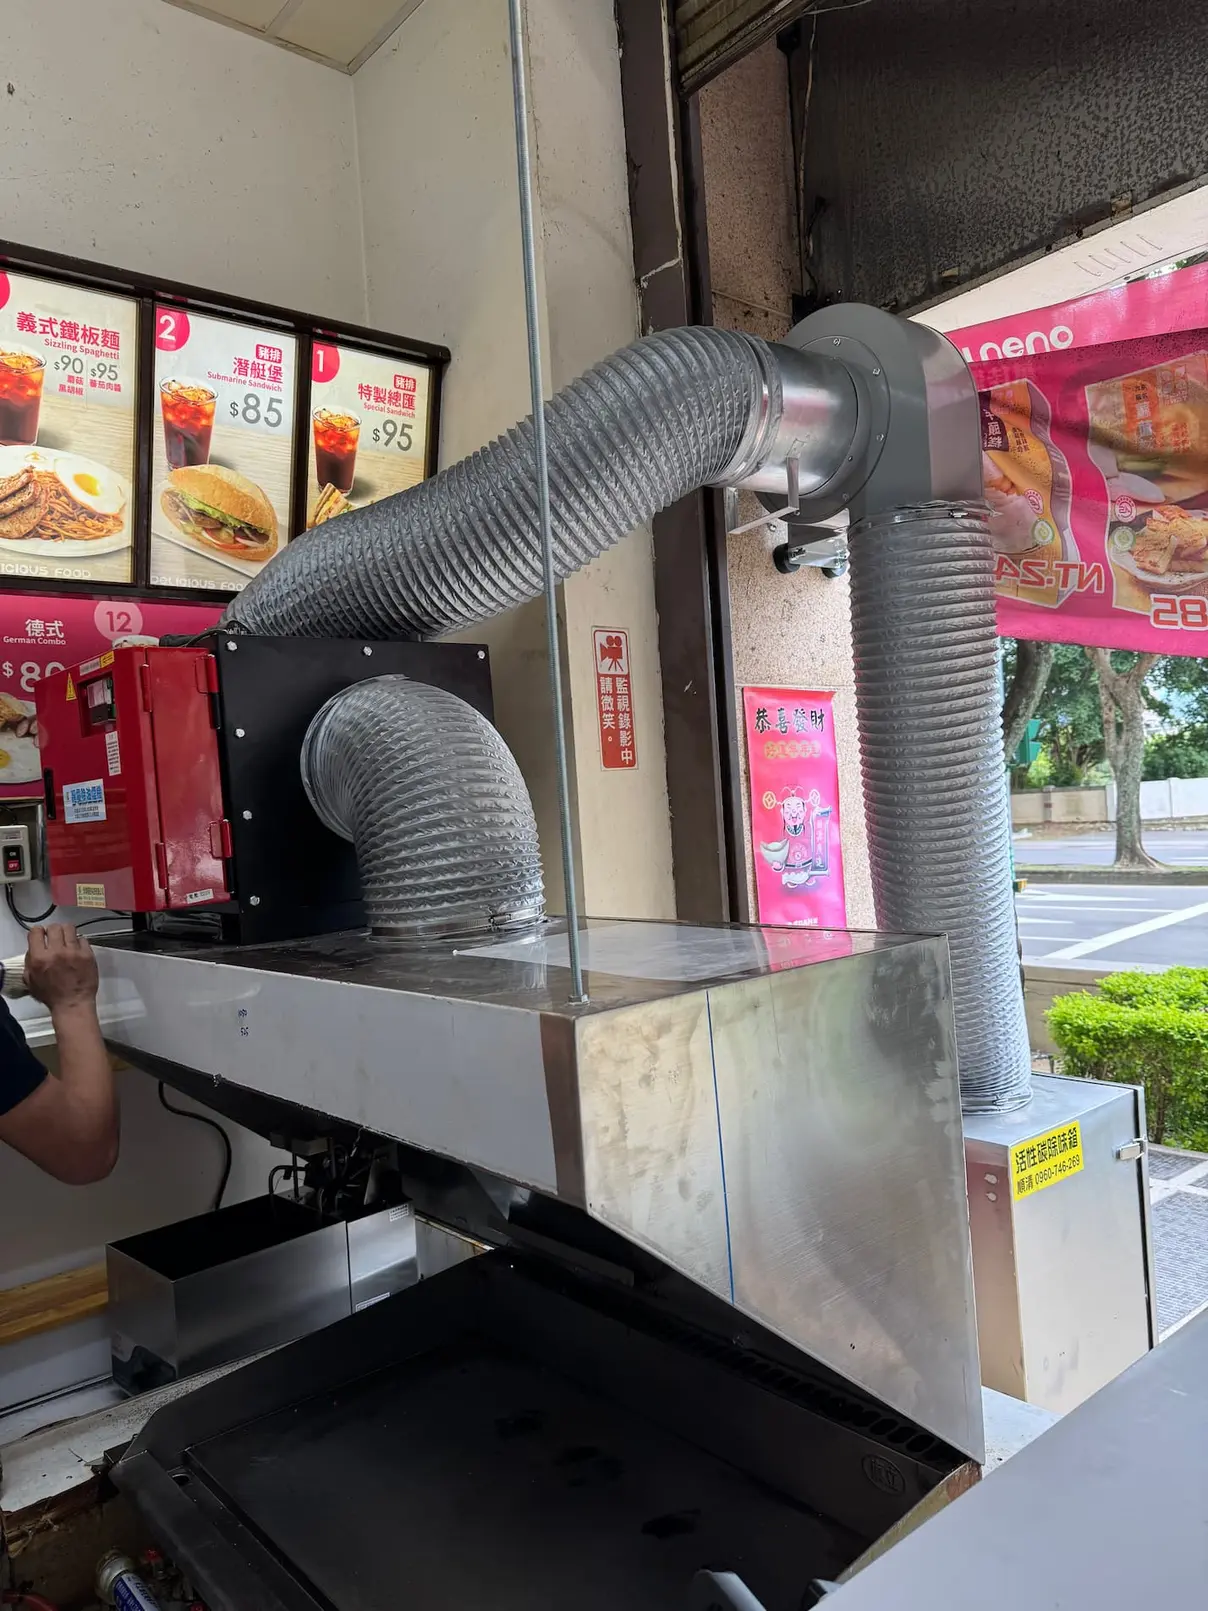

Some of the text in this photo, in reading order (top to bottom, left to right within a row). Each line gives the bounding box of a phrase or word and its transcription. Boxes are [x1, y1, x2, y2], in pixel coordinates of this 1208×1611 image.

[16, 311, 120, 351] 義式鐵板麵
[158, 314, 176, 341] 2
[44, 338, 120, 360] Sizzling Spaghetti
[257, 345, 281, 364] 豬排
[54, 354, 84, 374] $90
[90, 362, 118, 381] $95
[232, 356, 283, 384] 潛艇堡
[316, 350, 324, 372] 1
[208, 370, 282, 392] Submarine Sandwich
[395, 376, 415, 392] 豬排
[358, 383, 416, 410] 特製總匯
[230, 393, 282, 428] $85
[364, 402, 416, 418] Special Sandwich
[372, 419, 413, 452] $95
[54, 567, 91, 578] FOOD
[25, 618, 64, 638] 德式
[106, 611, 132, 633] 12
[4, 636, 66, 646] German Combo
[616, 677, 633, 764] 監視錄影中
[754, 708, 824, 734] 恭喜發財
[1015, 1127, 1078, 1174] 活性碳除味箱
[1034, 1154, 1080, 1185] 0960-746-269
